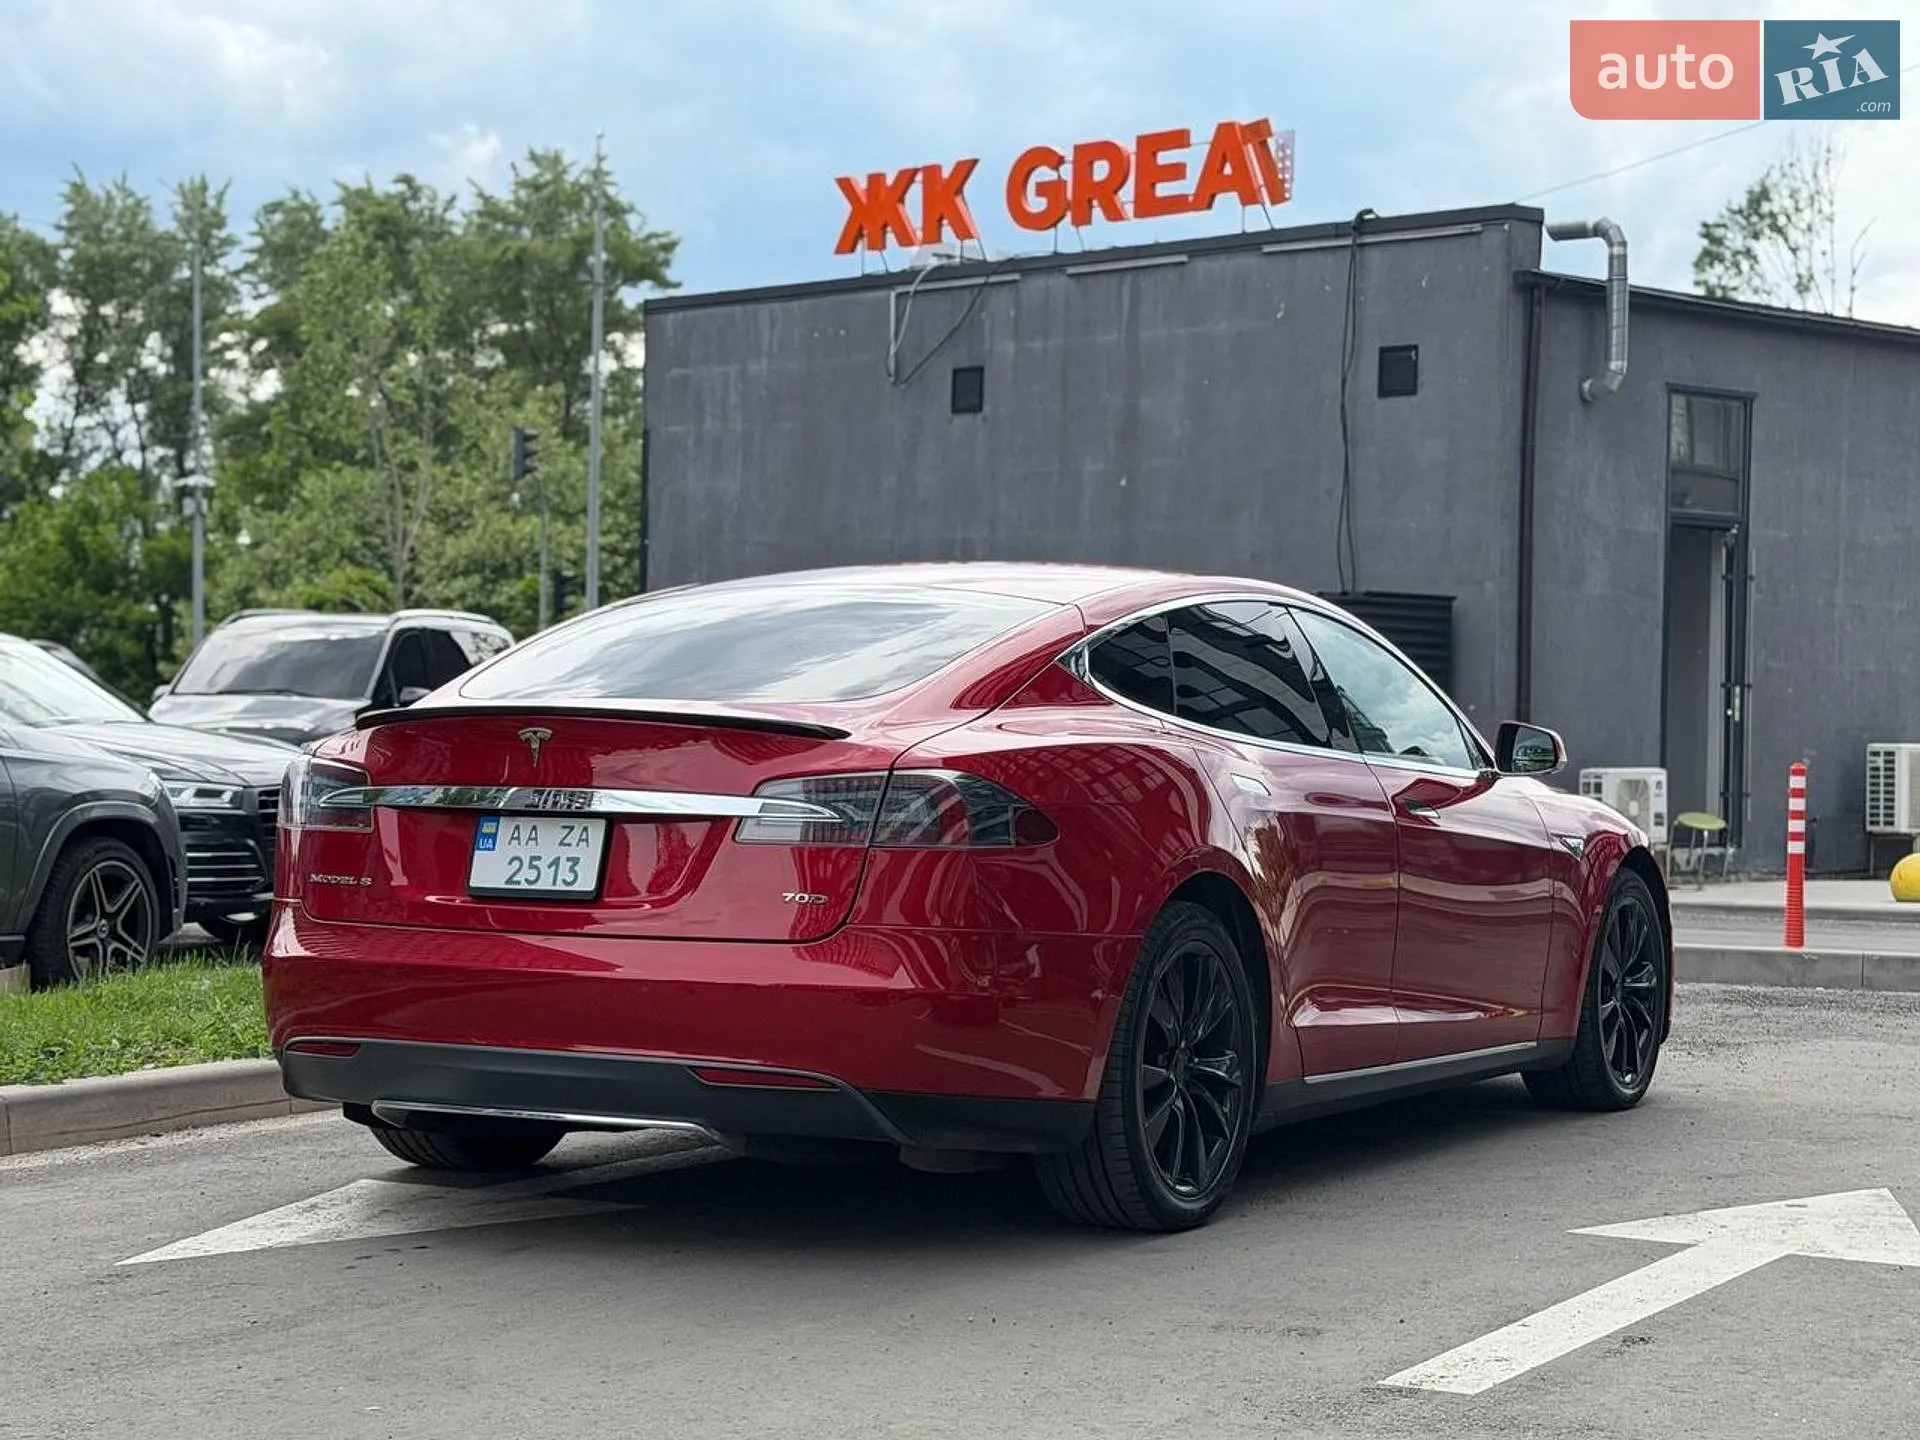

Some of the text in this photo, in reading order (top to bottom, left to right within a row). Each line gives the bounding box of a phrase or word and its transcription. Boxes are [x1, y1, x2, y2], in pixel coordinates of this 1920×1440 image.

[834, 117, 1291, 255] ЖК GREAT
[478, 837, 494, 850] UA
[507, 823, 590, 848] AA ZA
[309, 873, 373, 887] MODEL S
[503, 854, 582, 888] 2513
